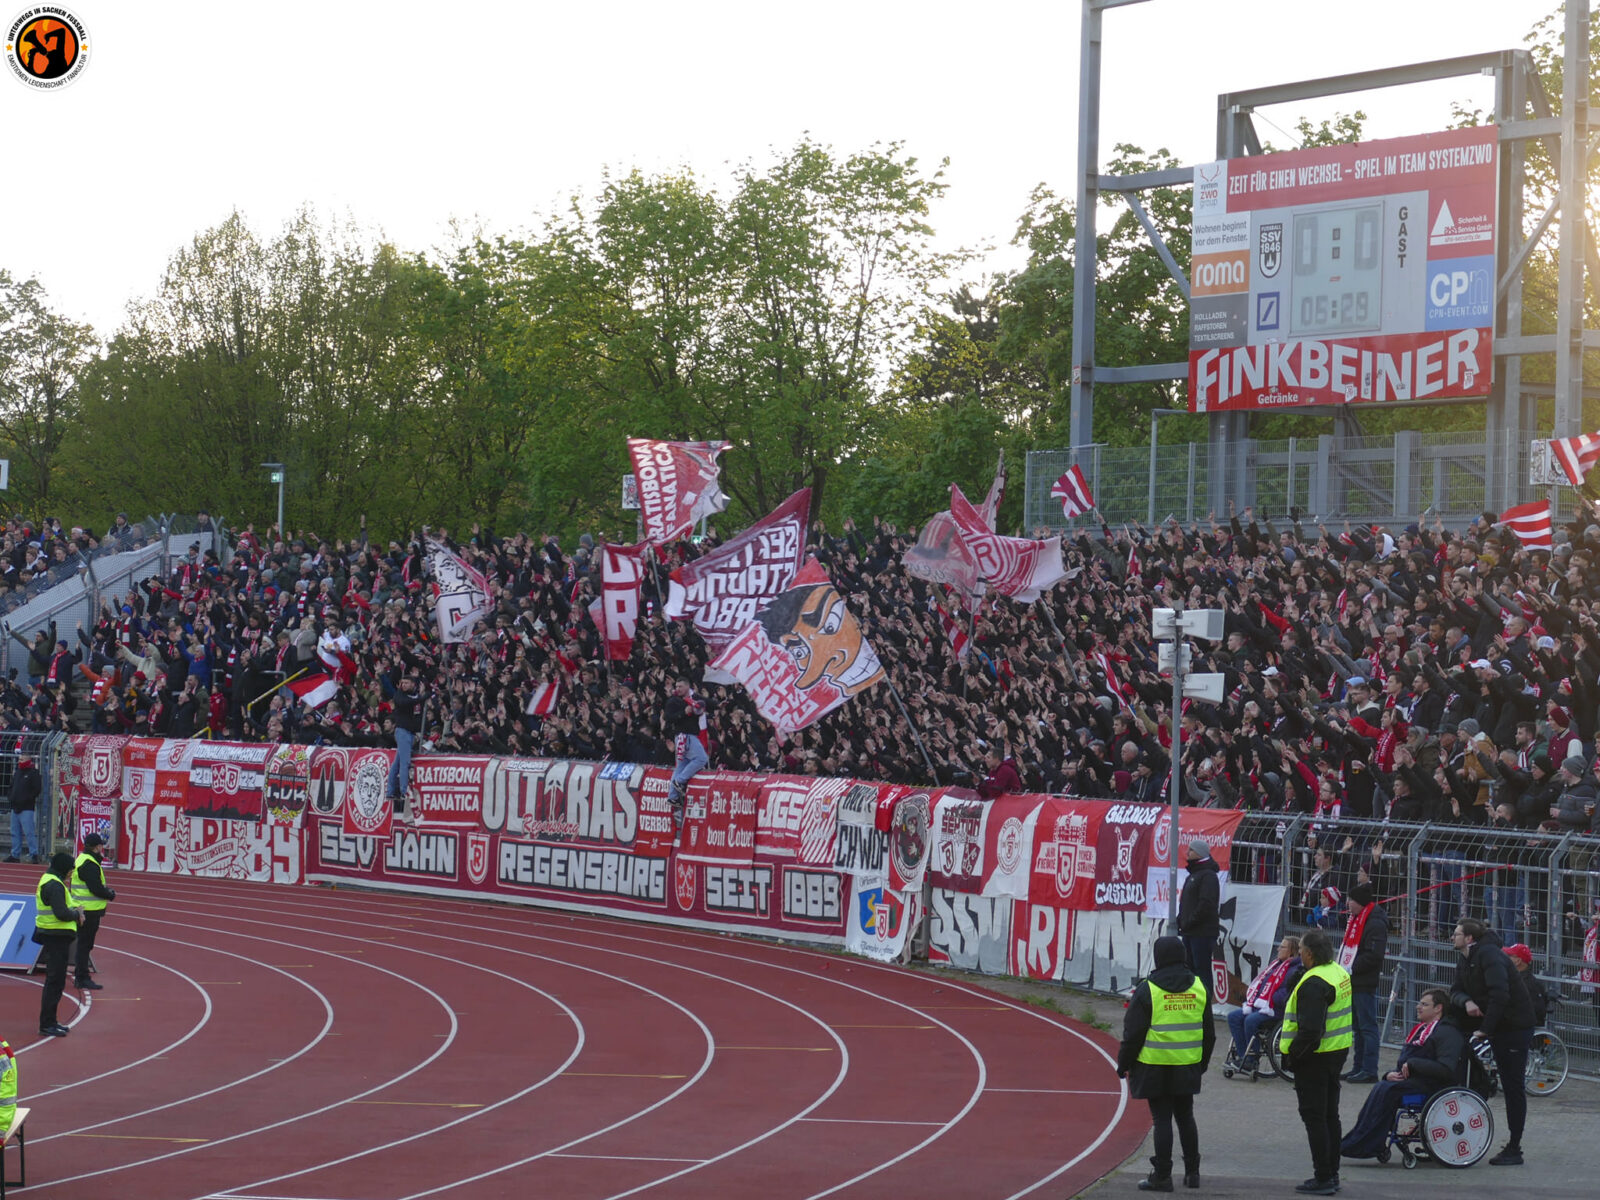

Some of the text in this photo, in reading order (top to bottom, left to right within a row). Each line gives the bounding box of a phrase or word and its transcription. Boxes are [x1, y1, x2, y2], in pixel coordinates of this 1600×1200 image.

[1229, 175, 1248, 195] ZEIT
[1250, 170, 1267, 192] FÜR
[1269, 168, 1296, 190] EINEN
[1299, 162, 1342, 186] WECHSEL
[1355, 158, 1381, 179] SPIEL
[1384, 156, 1396, 176] IM
[1400, 152, 1426, 174] TEAM
[1429, 143, 1492, 170] SYSTEMZWO
[1195, 221, 1247, 235] Wohnen beginnt
[1260, 231, 1281, 243] SSV
[1397, 207, 1408, 268] GAST
[1195, 239, 1205, 247] vor
[1206, 236, 1220, 246] dem
[1260, 242, 1281, 254] 1846
[1195, 260, 1245, 287] roma
[1196, 328, 1480, 412] FINKBEINER
[1257, 391, 1299, 405] Getränke
[416, 765, 481, 784] RATISBONA
[422, 793, 480, 812] FANATICA
[711, 790, 728, 814] Die
[758, 790, 806, 831] JGS
[707, 826, 726, 847] vom
[321, 823, 455, 875] SSV JAHN
[500, 842, 665, 900] REGENSBURG
[707, 867, 840, 918] SEIT 1889
[1163, 1003, 1197, 1011] SECURITY
